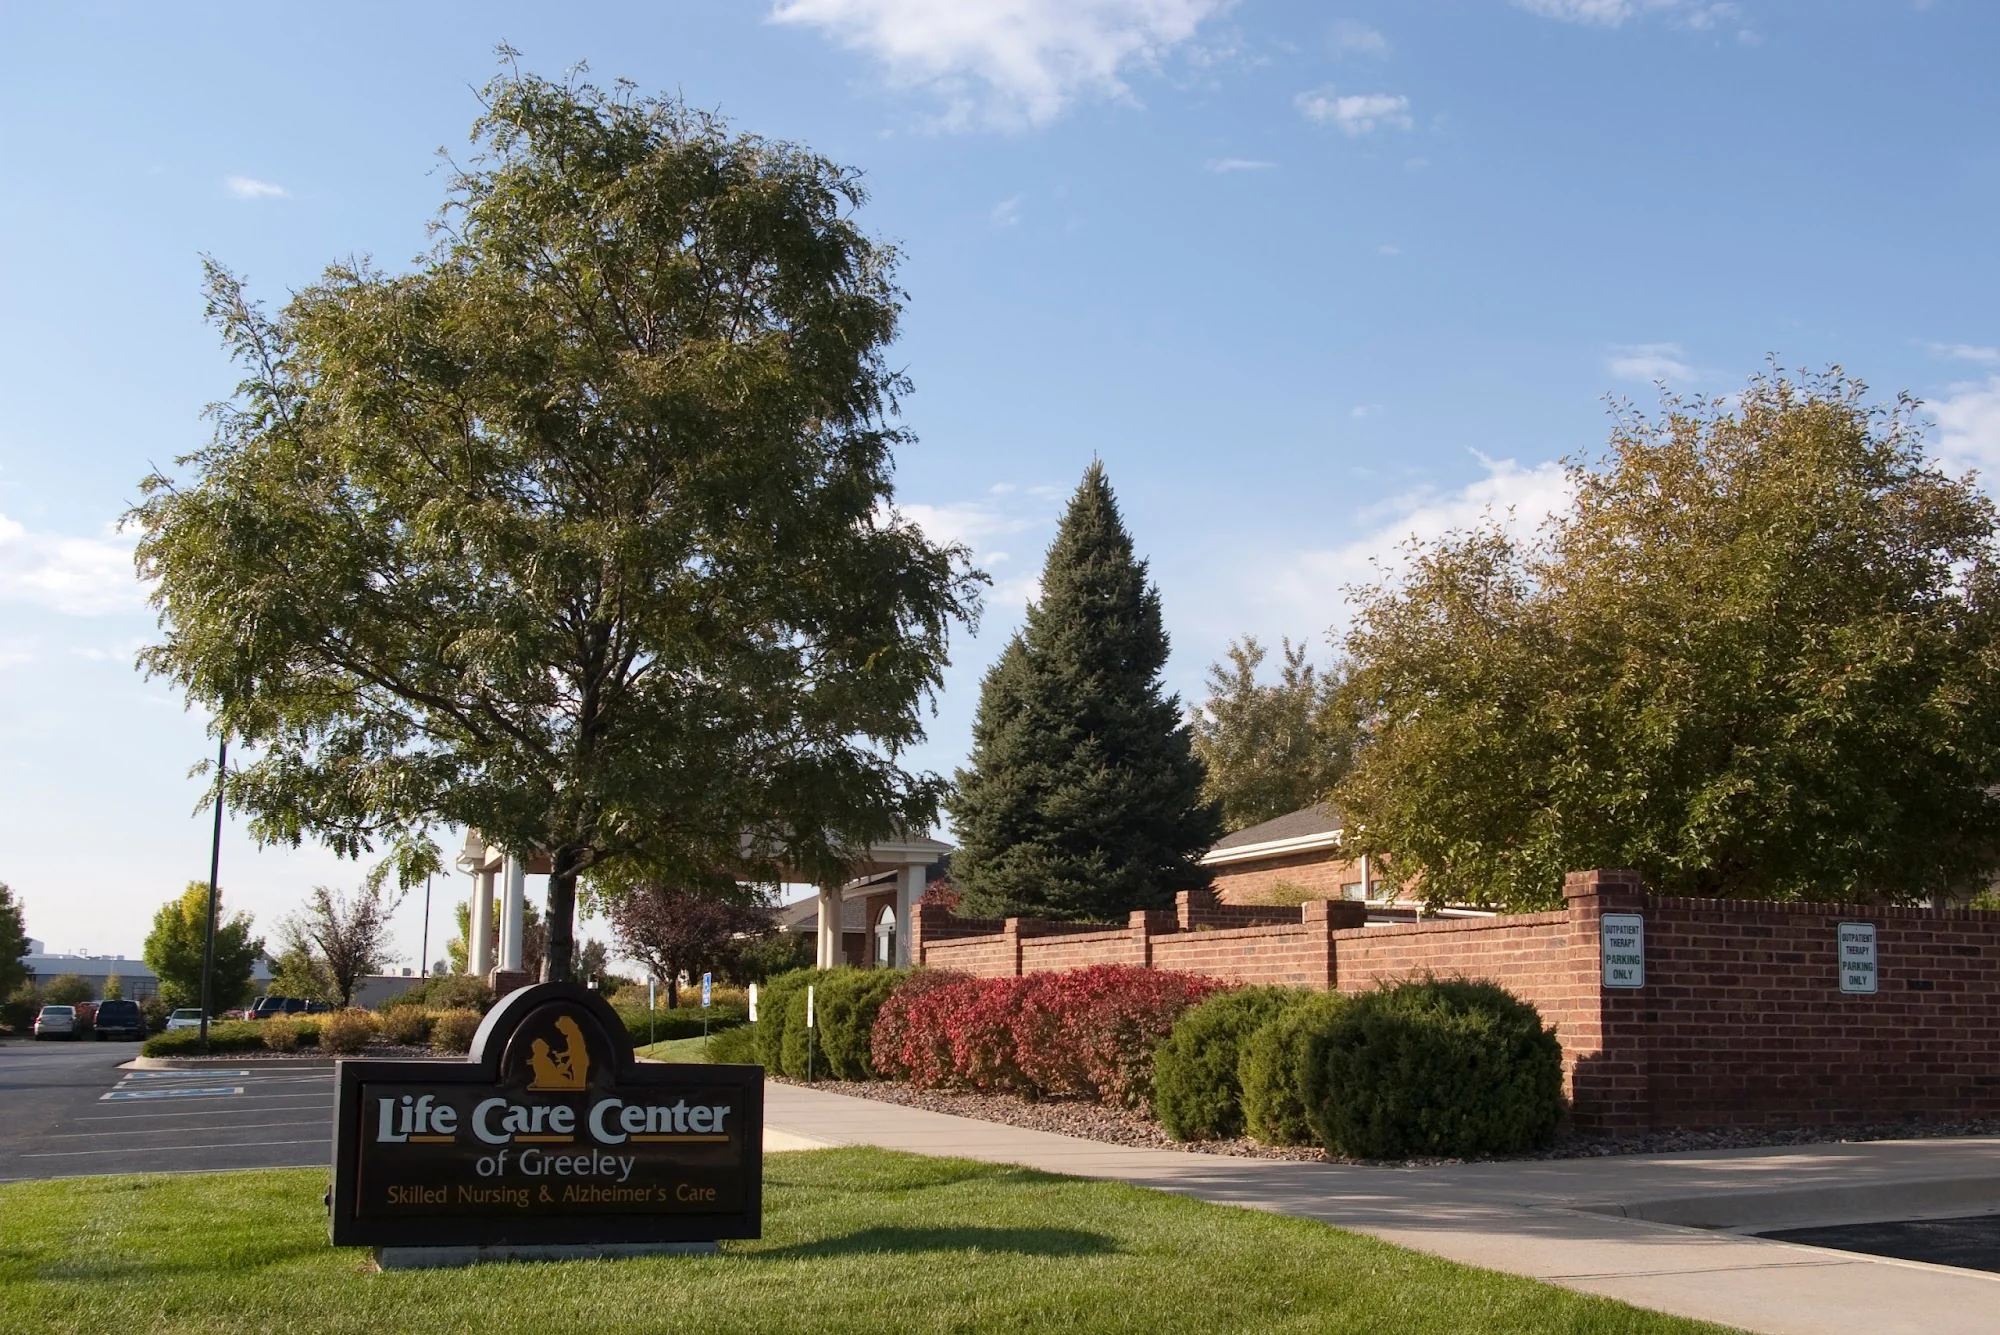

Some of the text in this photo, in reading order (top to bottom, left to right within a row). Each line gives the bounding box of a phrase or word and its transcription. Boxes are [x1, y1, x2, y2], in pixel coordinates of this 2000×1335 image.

[1604, 924, 1640, 935] OUTPATIENT
[1609, 938, 1636, 948] THERAPY
[1840, 932, 1873, 943] OUTPATIENT
[1845, 945, 1870, 955] THERAPY
[1605, 954, 1640, 965] PARKING
[1841, 961, 1874, 972] PARKING
[1612, 969, 1634, 980] ONLY
[1848, 975, 1868, 986] ONLY
[376, 1094, 731, 1145] Life Care Center
[475, 1148, 636, 1183] of Greeley
[387, 1183, 717, 1208] Skilled Nursing & Alzheimer's Care
